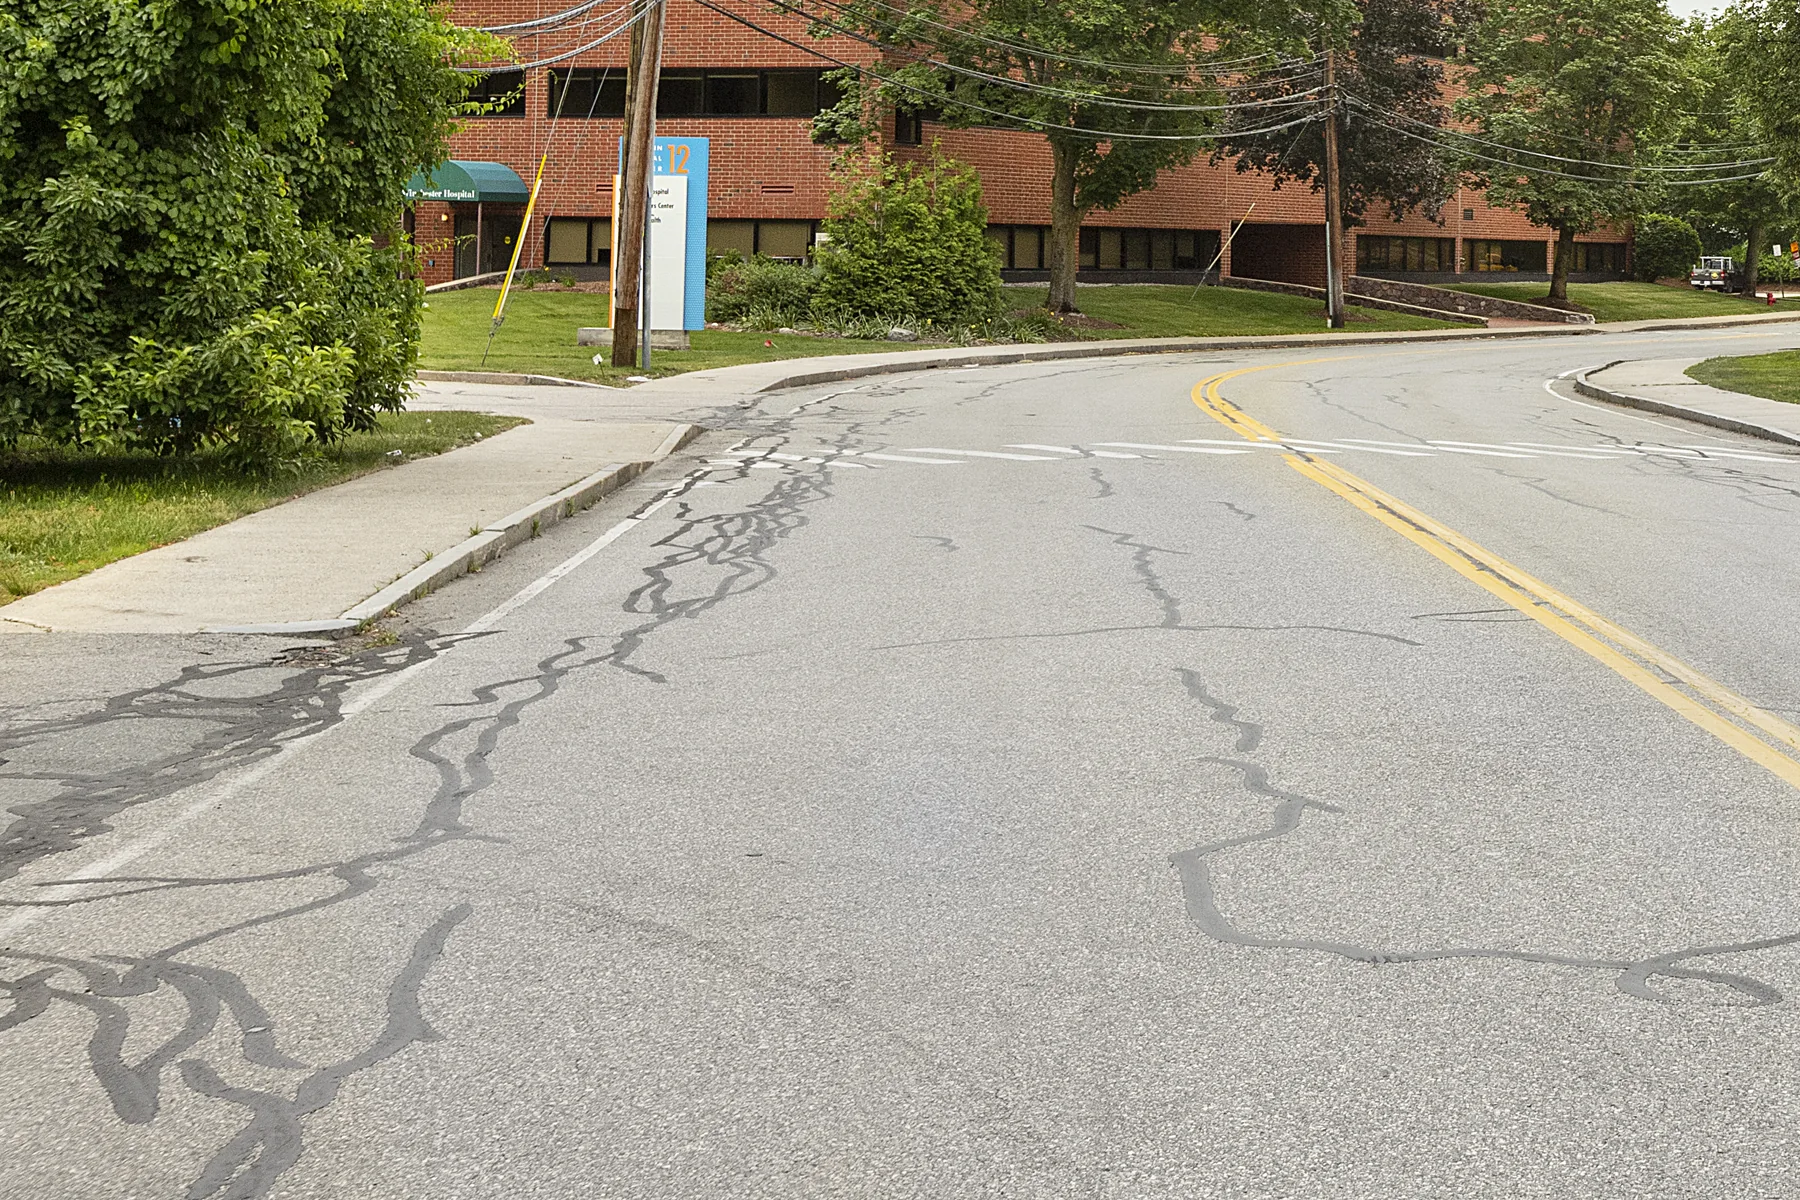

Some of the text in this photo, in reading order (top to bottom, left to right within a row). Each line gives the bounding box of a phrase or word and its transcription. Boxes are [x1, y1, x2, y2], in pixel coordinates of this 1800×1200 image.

[667, 144, 690, 174] 12
[443, 189, 475, 200] Hospital
[653, 188, 669, 196] ospital
